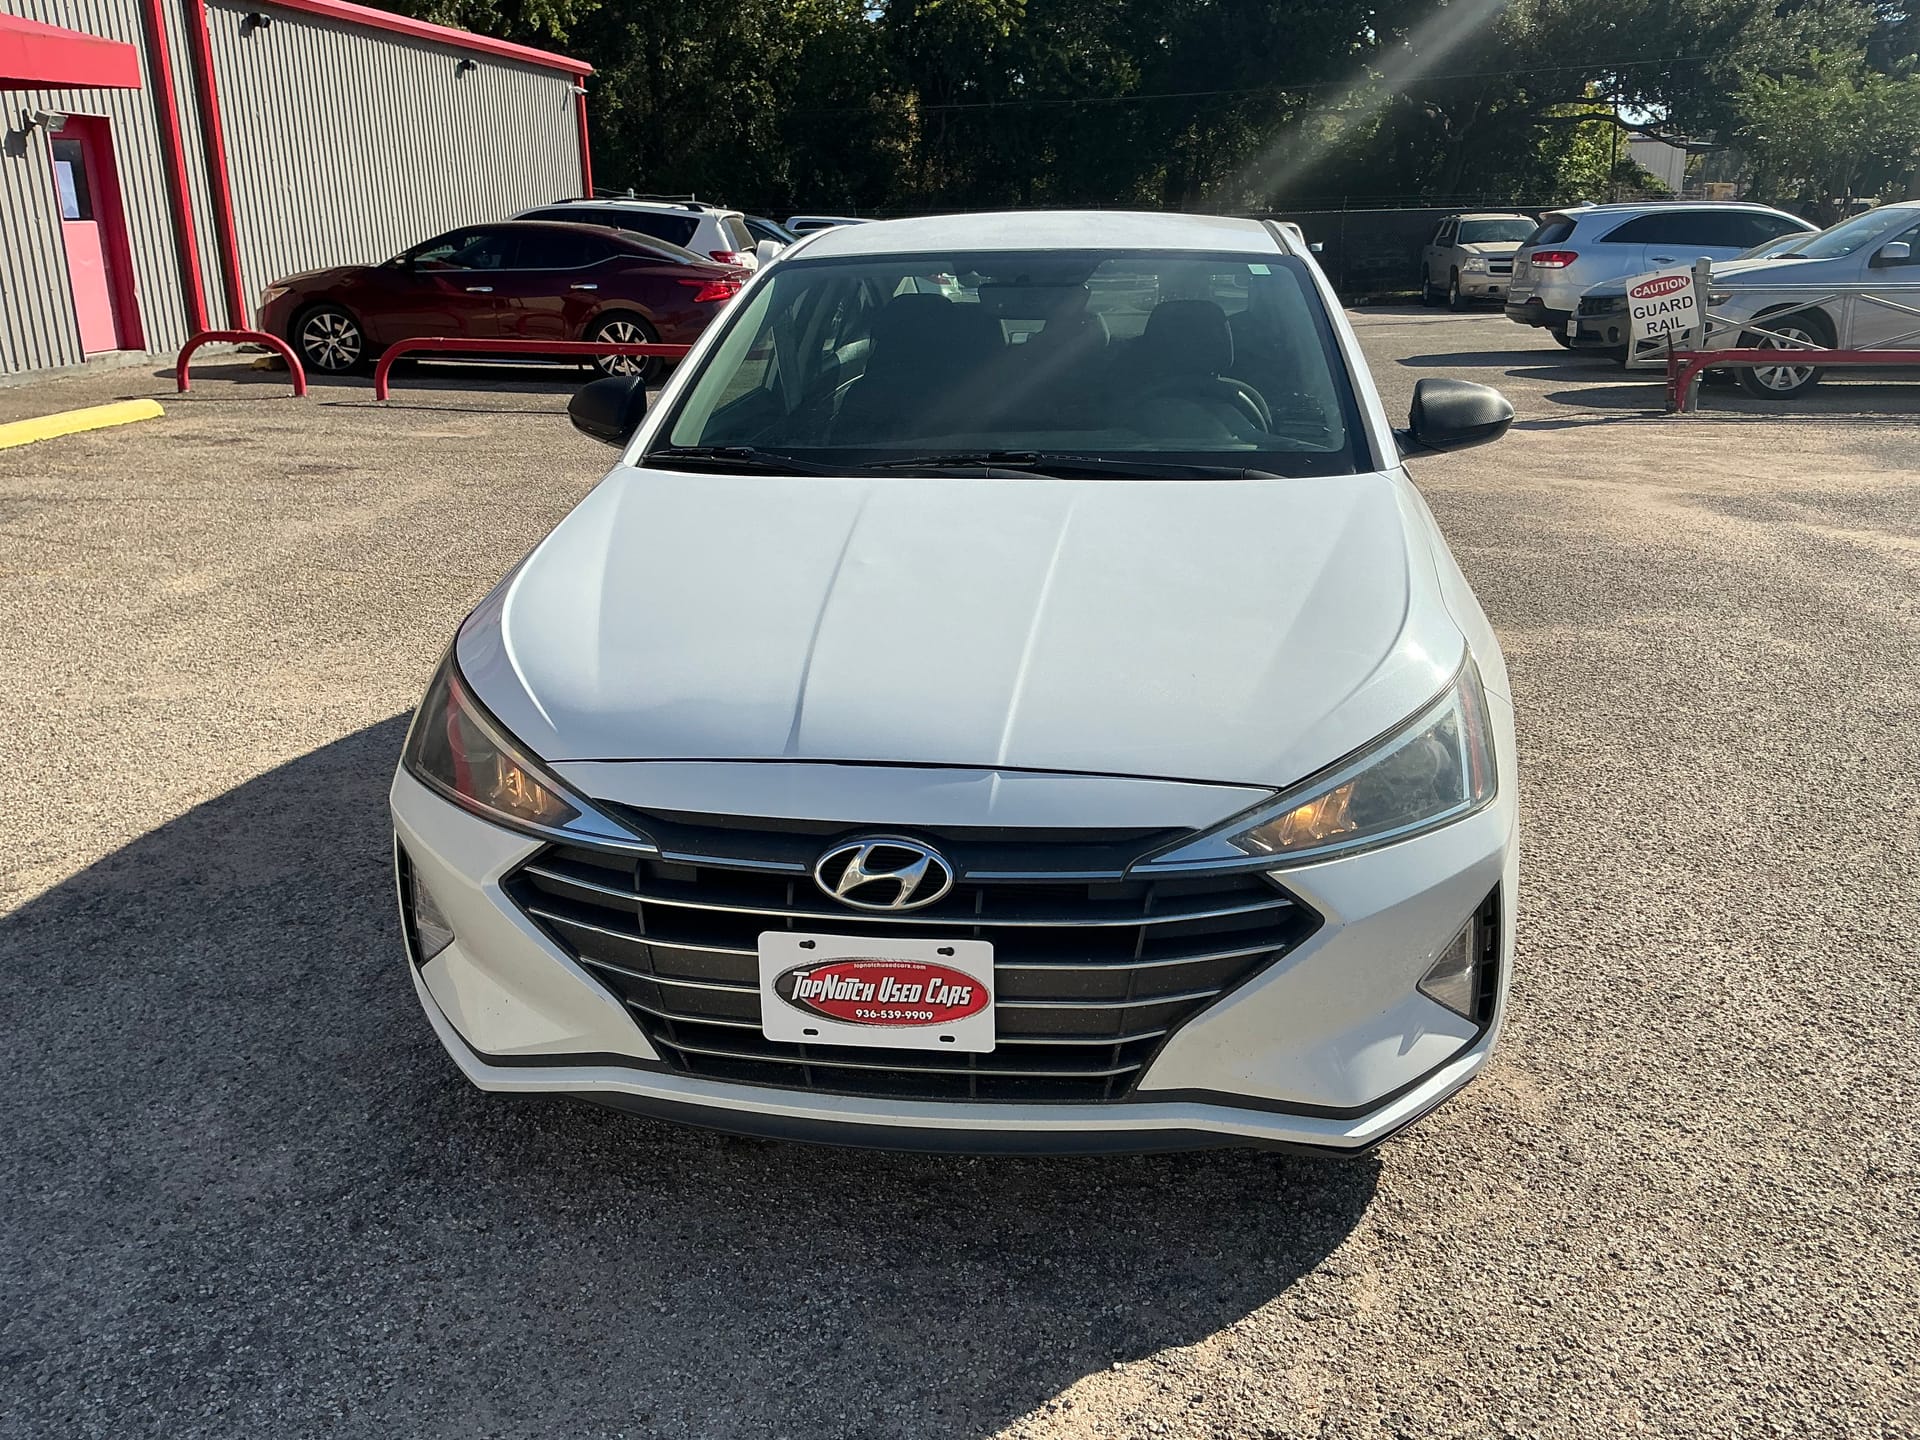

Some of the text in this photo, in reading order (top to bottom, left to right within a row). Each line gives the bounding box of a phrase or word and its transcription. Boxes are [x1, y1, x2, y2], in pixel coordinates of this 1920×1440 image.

[1634, 277, 1687, 297] CAUTION
[1634, 296, 1693, 319] GUARD
[1646, 317, 1685, 334] RAIL
[854, 962, 926, 970] topnotchusedcars.com
[855, 1009, 933, 1020] 936-539-9909
